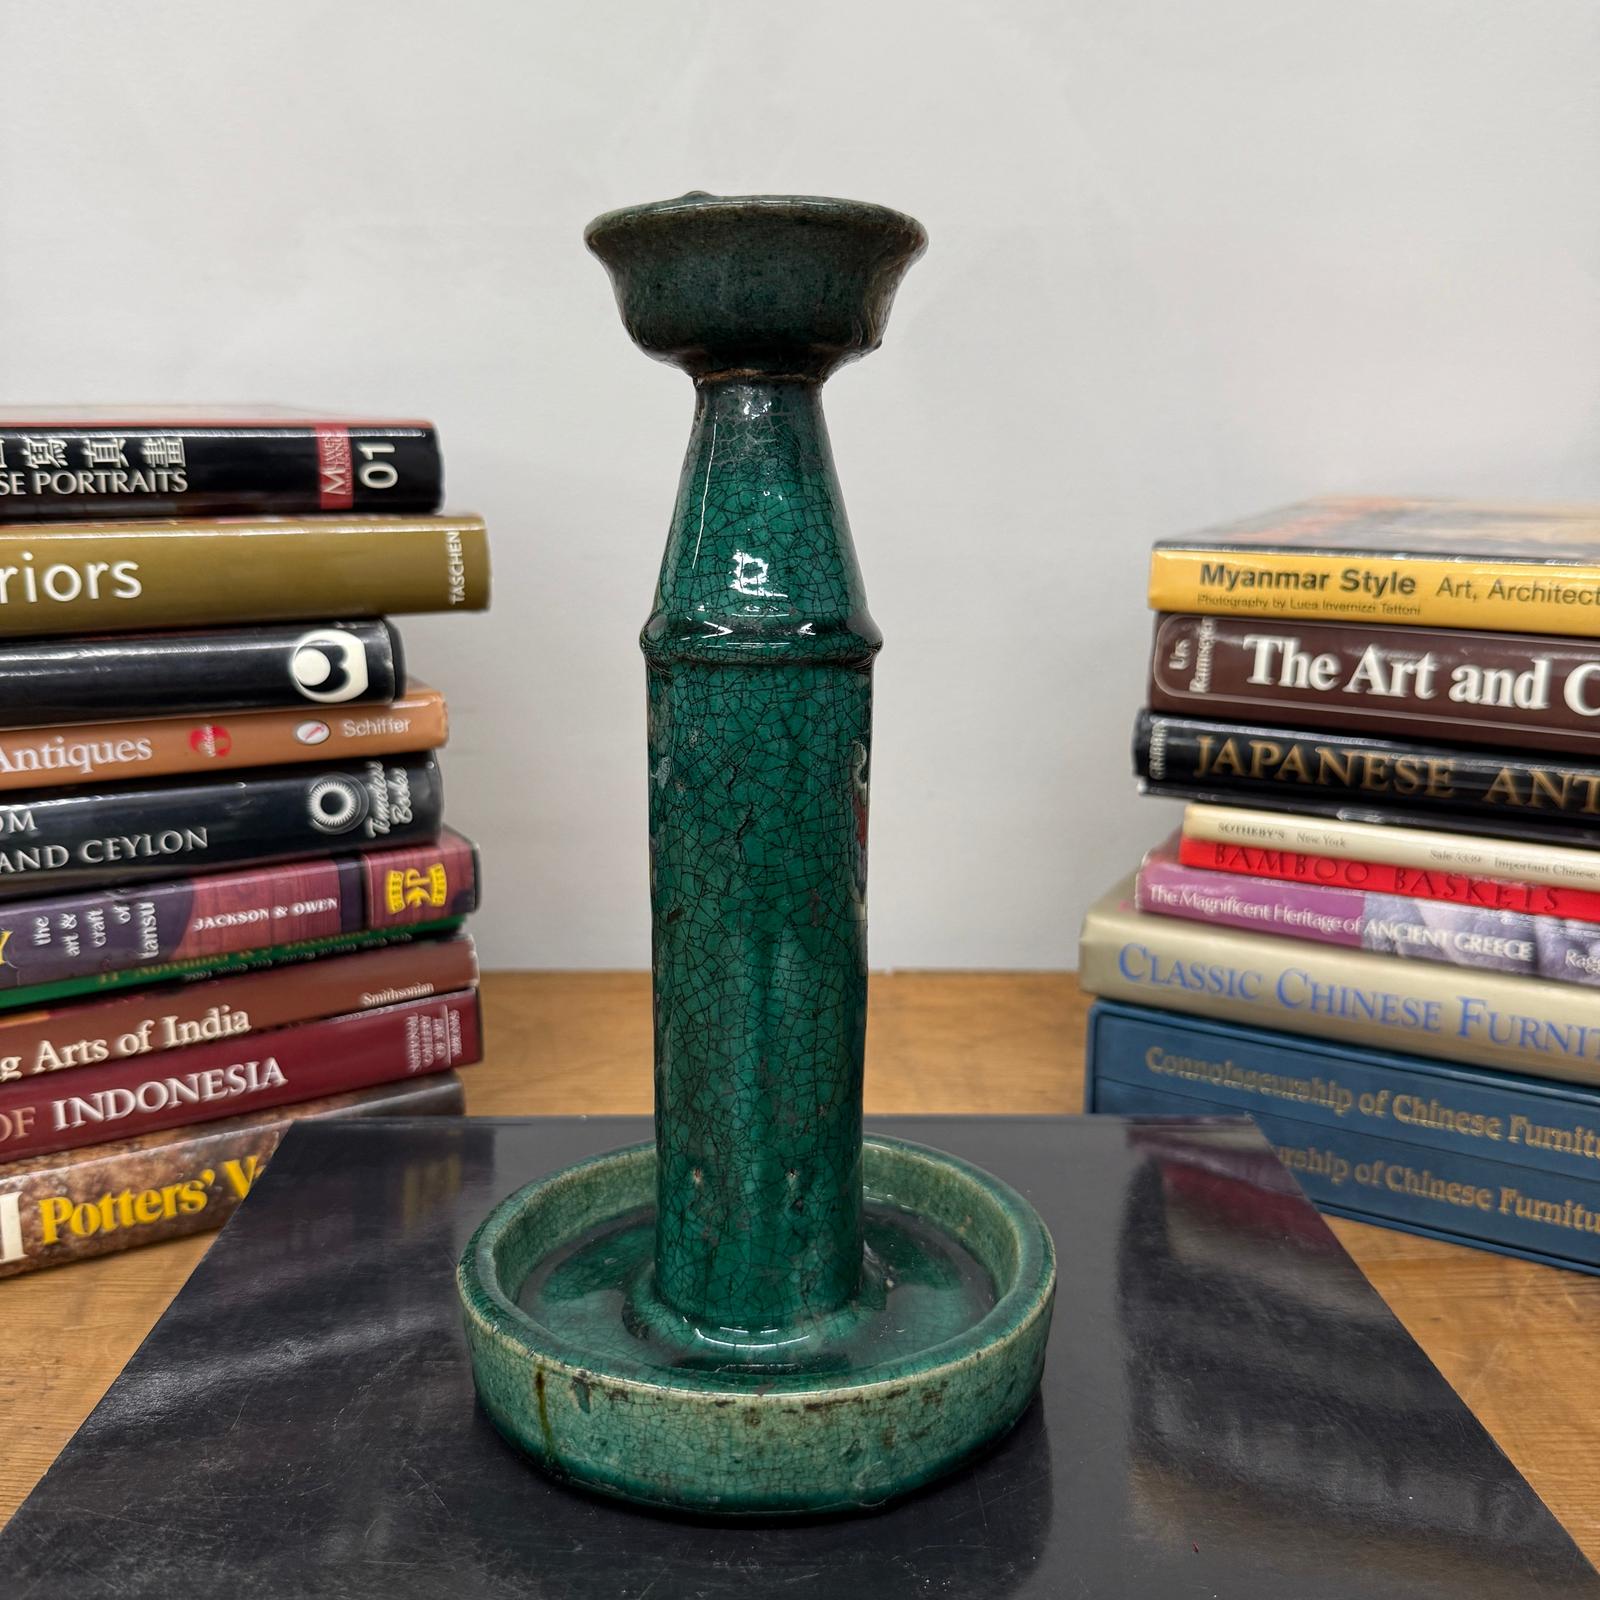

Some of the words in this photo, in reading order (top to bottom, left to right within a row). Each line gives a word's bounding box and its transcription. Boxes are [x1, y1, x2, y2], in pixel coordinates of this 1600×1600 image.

[32, 468, 188, 495] PORTRAITS
[357, 442, 398, 490] 01
[447, 530, 466, 605] TASCHEN
[1199, 563, 1331, 592] Myanmar
[1339, 568, 1417, 598] Style
[1435, 576, 1478, 603] Art,
[1487, 579, 1600, 606] Architect
[1197, 592, 1270, 609] Photography
[1272, 597, 1287, 610] by
[1290, 597, 1319, 610] Luca
[1322, 600, 1376, 613] Invernizzi
[1381, 603, 1422, 616] Tettoni
[1168, 638, 1191, 670] Urs
[1243, 634, 1341, 691] The
[1342, 644, 1439, 700] Art
[1449, 657, 1552, 710] and
[342, 718, 412, 738] Schiffer
[1194, 735, 1456, 798] JAPANESE
[0, 810, 39, 834] M
[79, 826, 209, 863] CEYLON
[1214, 843, 1370, 884] BAMBOO
[1217, 822, 1286, 841] SOTHEBY'S
[1296, 832, 1319, 845] New
[1322, 834, 1347, 849] York
[1494, 857, 1550, 873] Important
[34, 915, 52, 946] the
[59, 913, 78, 930] &
[86, 907, 107, 948] craft
[112, 904, 131, 925] of
[138, 902, 160, 960] tansu
[193, 907, 271, 932] JACKSON
[272, 905, 289, 919] &
[290, 897, 338, 917] OWEN
[1150, 884, 1178, 904] The
[1179, 889, 1274, 918] Magnificent
[1274, 903, 1343, 934] Heritage
[1342, 915, 1362, 934] of
[1364, 918, 1452, 949] ANCIENT
[1454, 931, 1537, 962] GREECE
[61, 932, 81, 957] art
[361, 982, 435, 1007] Smithsonian
[1118, 942, 1263, 1001] CLASSIC
[1275, 967, 1442, 1034] CHINESE
[32, 1039, 109, 1074] Arts
[115, 1019, 155, 1057] of
[162, 1004, 252, 1048] India
[51, 1056, 289, 1130] INDONESIA
[1358, 1089, 1390, 1118] of
[1392, 1094, 1503, 1141] Chinese
[1353, 1160, 1385, 1186] of
[1385, 1164, 1493, 1211] Chinese
[38, 1167, 216, 1247] Potters'
